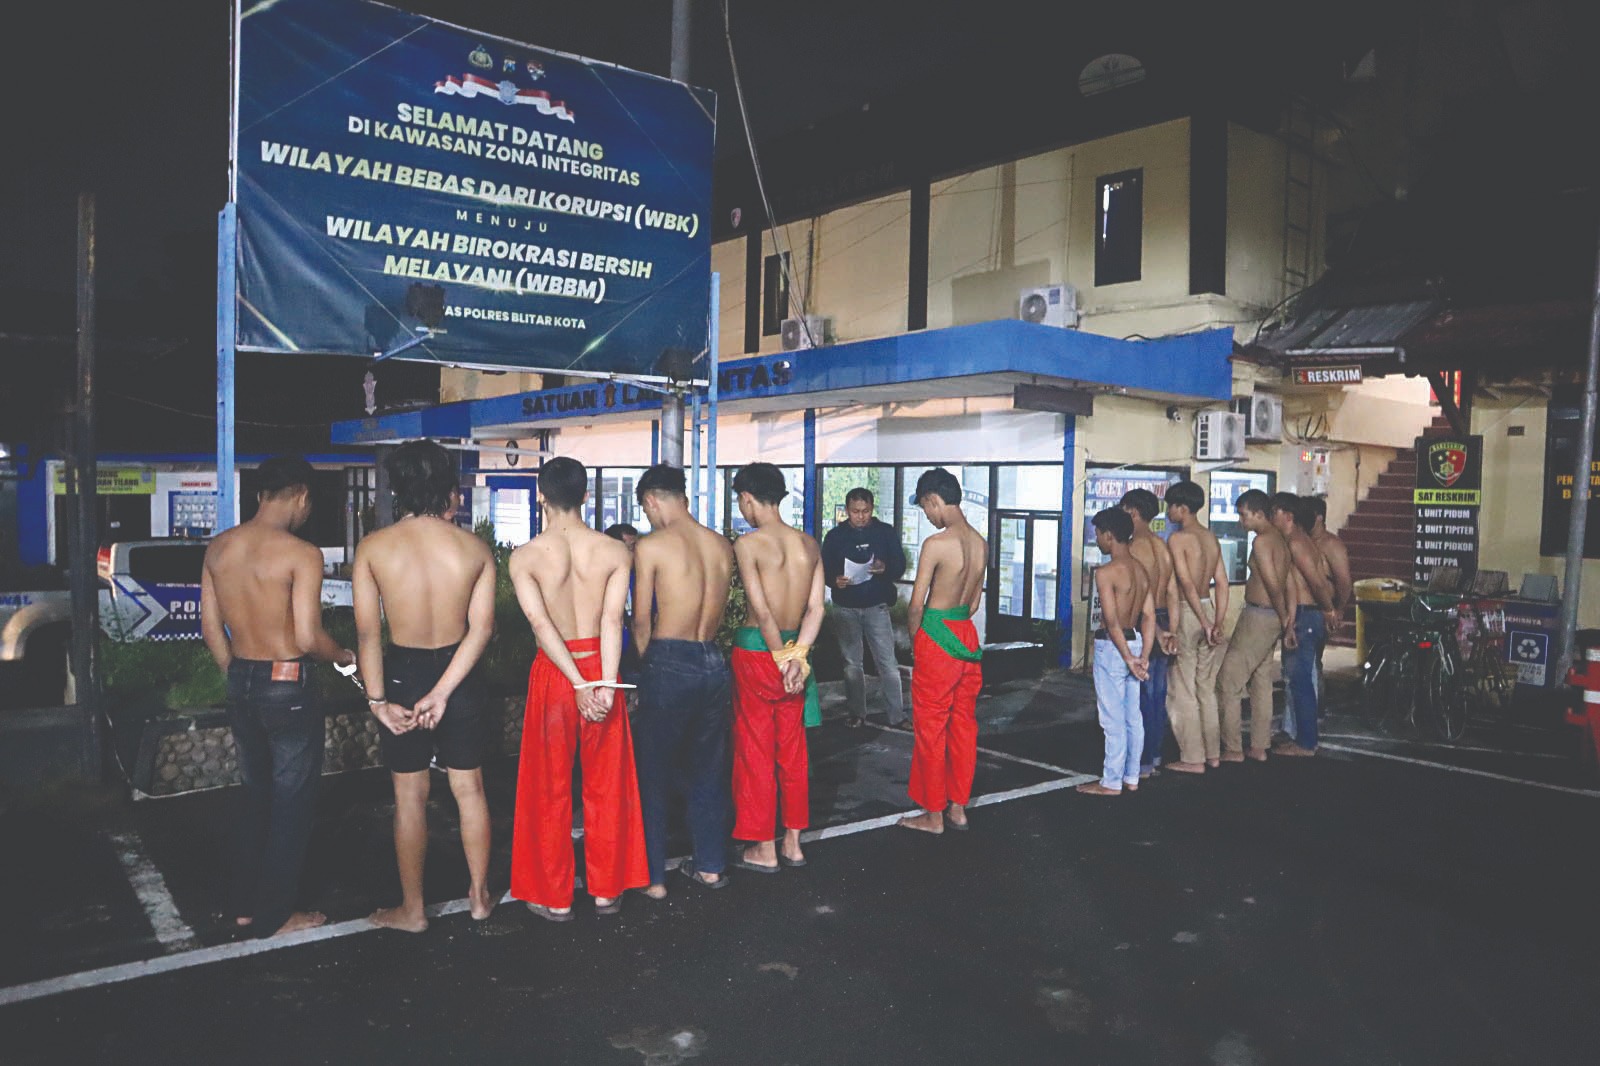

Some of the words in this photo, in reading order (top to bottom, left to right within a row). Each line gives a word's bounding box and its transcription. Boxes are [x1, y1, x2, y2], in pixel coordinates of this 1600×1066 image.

[397, 102, 509, 142] SELAMAT
[512, 126, 604, 160] DATANG
[348, 115, 370, 136] DI
[374, 120, 482, 157] KAWASAN
[485, 143, 538, 168] ZONA
[541, 153, 641, 187] INTEGRITAS
[261, 140, 393, 183] WILAYAH
[394, 165, 477, 197] BEBAS
[478, 180, 537, 208] DARI
[538, 190, 632, 223] KORUPSI
[634, 203, 699, 239] (WBK)
[326, 215, 450, 253] WILAYAH
[452, 234, 577, 269] BIROKRASI
[579, 249, 653, 279] BERSIH
[383, 255, 512, 289] MELAYANI
[515, 267, 607, 304] (WBBM)
[463, 307, 509, 322] POLRES
[511, 311, 553, 328] BLITAR
[553, 316, 587, 330] KOTA
[1307, 368, 1361, 384] RESKRIM
[521, 388, 598, 416] SATUAN
[1418, 491, 1433, 502] SAT
[1435, 491, 1476, 502] RESKRIM
[1424, 509, 1442, 518] UNIT
[1416, 524, 1424, 534] 2.
[1425, 525, 1443, 534] UNIT
[1424, 541, 1443, 551] UNIT
[1423, 557, 1441, 567] UNIT
[1442, 557, 1458, 567] PPA
